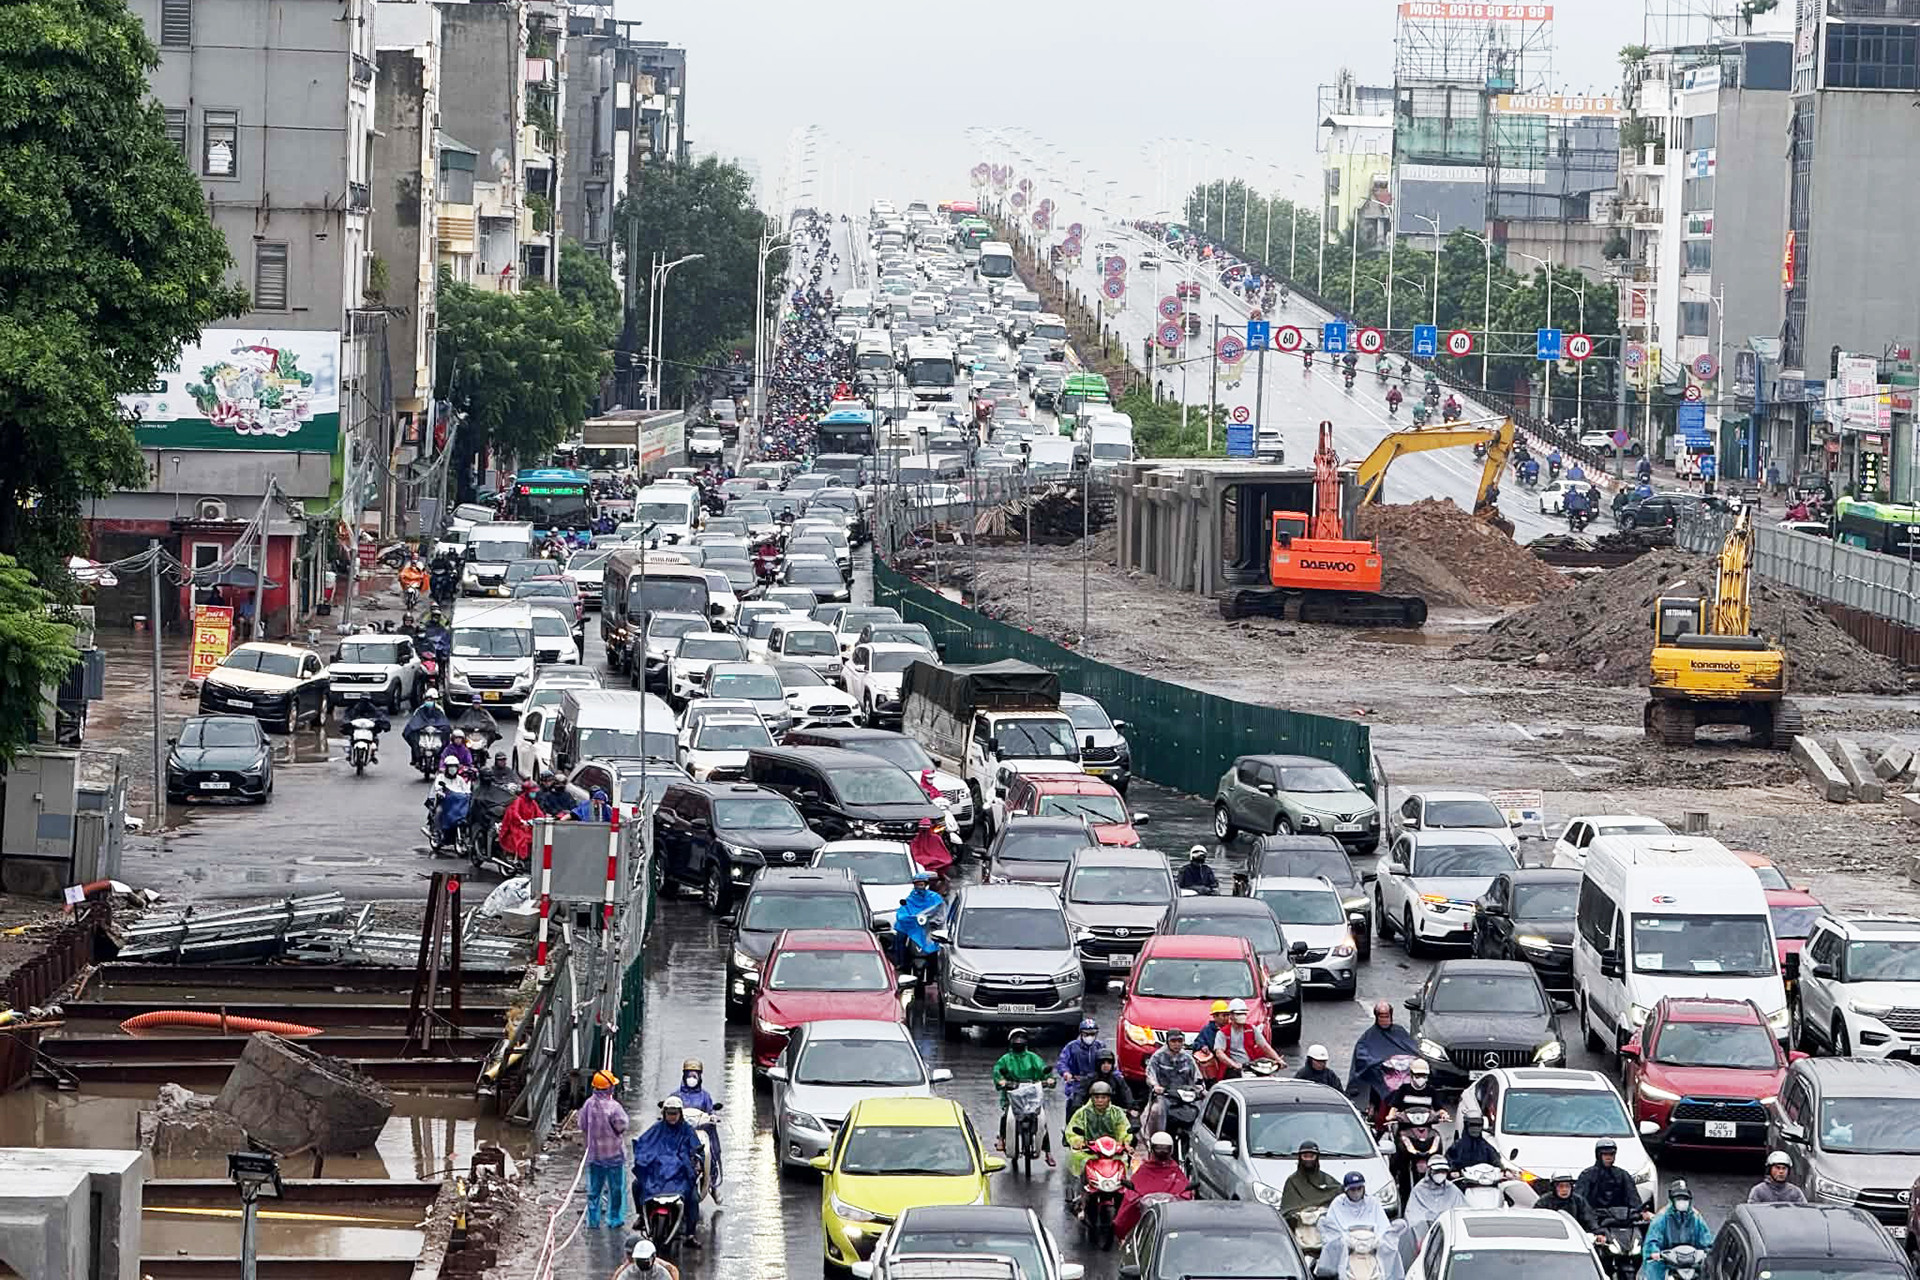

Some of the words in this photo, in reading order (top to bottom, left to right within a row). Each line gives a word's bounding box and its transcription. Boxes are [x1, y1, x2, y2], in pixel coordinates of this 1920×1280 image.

[1449, 5, 1483, 16] 0916
[1487, 6, 1504, 17] 80
[1507, 6, 1524, 17] 20
[1528, 6, 1546, 17] 99
[1562, 98, 1606, 111] 0916
[1282, 332, 1294, 345] 60
[1365, 334, 1376, 346] 60
[1454, 337, 1466, 349] 60
[1573, 341, 1586, 353] 40
[1300, 559, 1356, 572] DAEWOO
[1690, 659, 1741, 670] kanamoto
